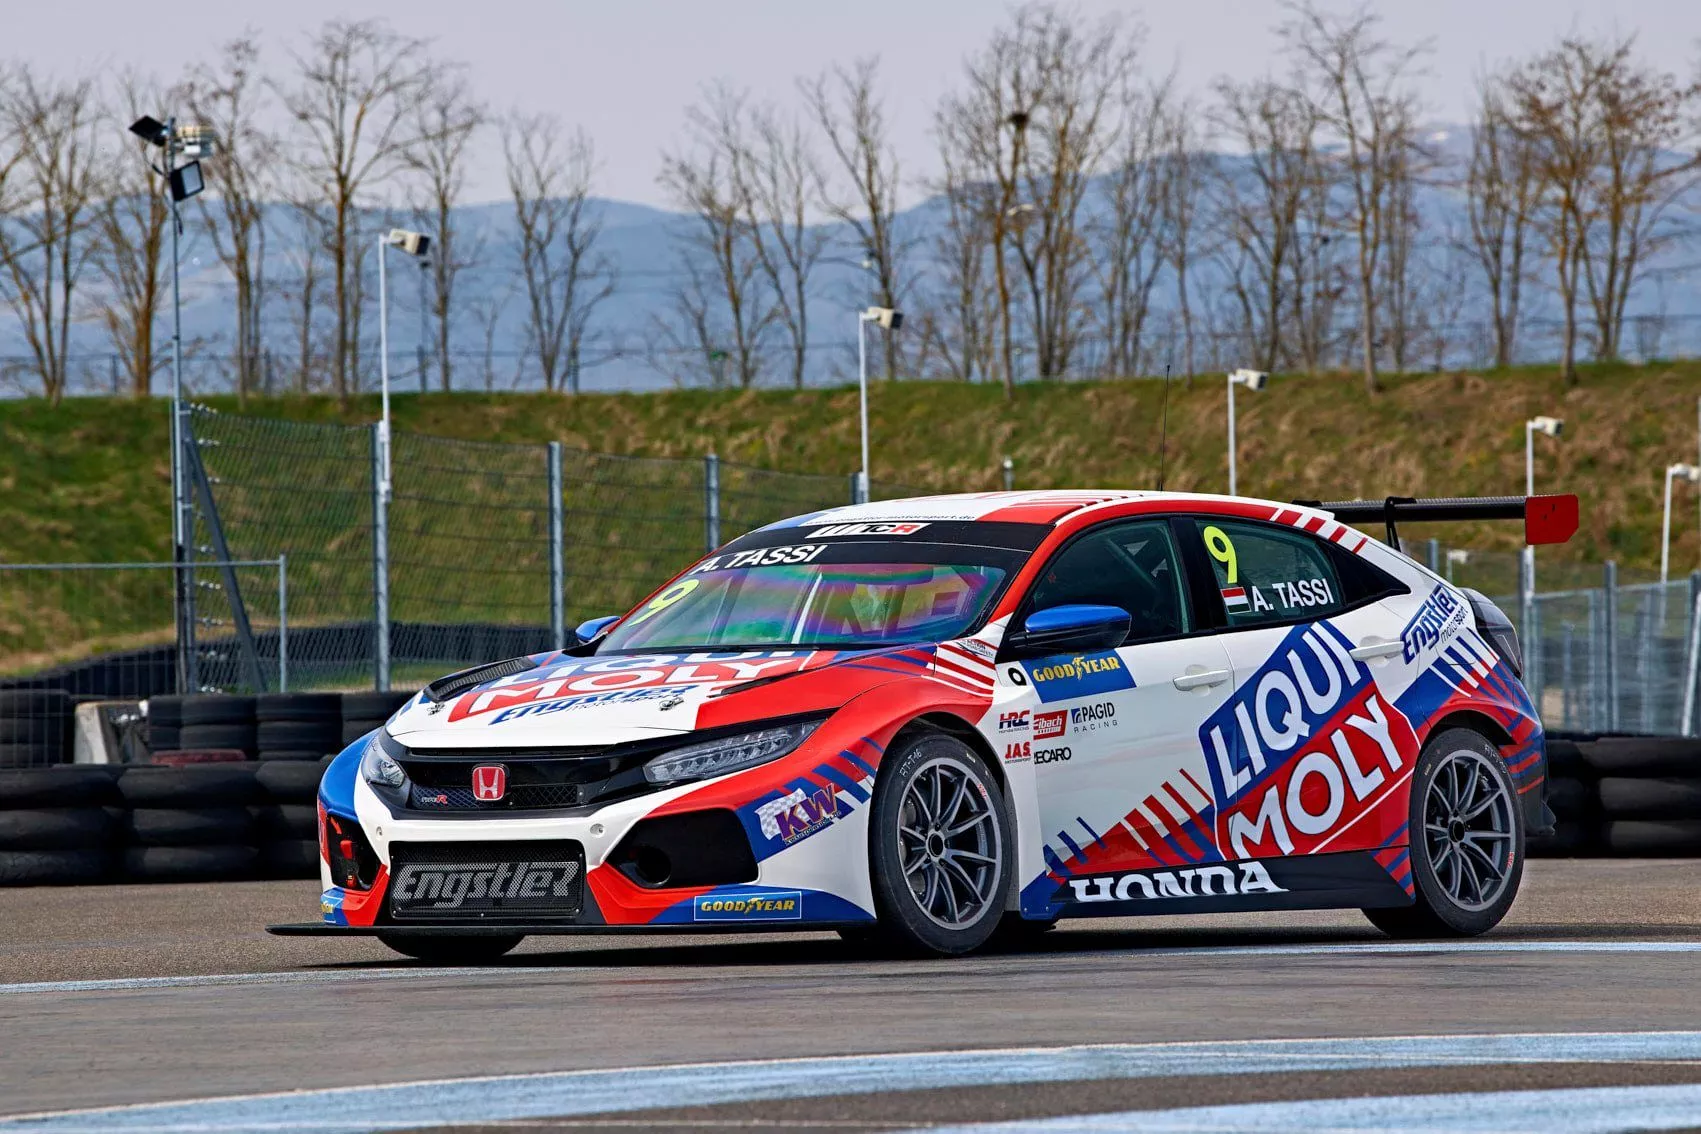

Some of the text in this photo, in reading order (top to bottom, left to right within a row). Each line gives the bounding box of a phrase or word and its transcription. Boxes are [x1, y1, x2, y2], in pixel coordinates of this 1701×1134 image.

[689, 545, 828, 576] A. TASSI
[1204, 525, 1238, 584] 9
[627, 579, 700, 627] 9
[1251, 578, 1335, 612] A. TASSI
[1400, 583, 1459, 665] Engstler
[467, 658, 797, 715] MOLY
[1032, 656, 1121, 682] GOODYEAR
[998, 710, 1031, 730] HRC
[1074, 719, 1118, 734] RACING
[1081, 702, 1115, 722] PAGID
[1209, 621, 1362, 800] LIQUI
[1228, 694, 1404, 860] MOLY
[775, 782, 839, 841] KW
[392, 861, 580, 909] Engstler
[1069, 860, 1290, 903] HONDA
[701, 897, 795, 914] GOODYEAR
